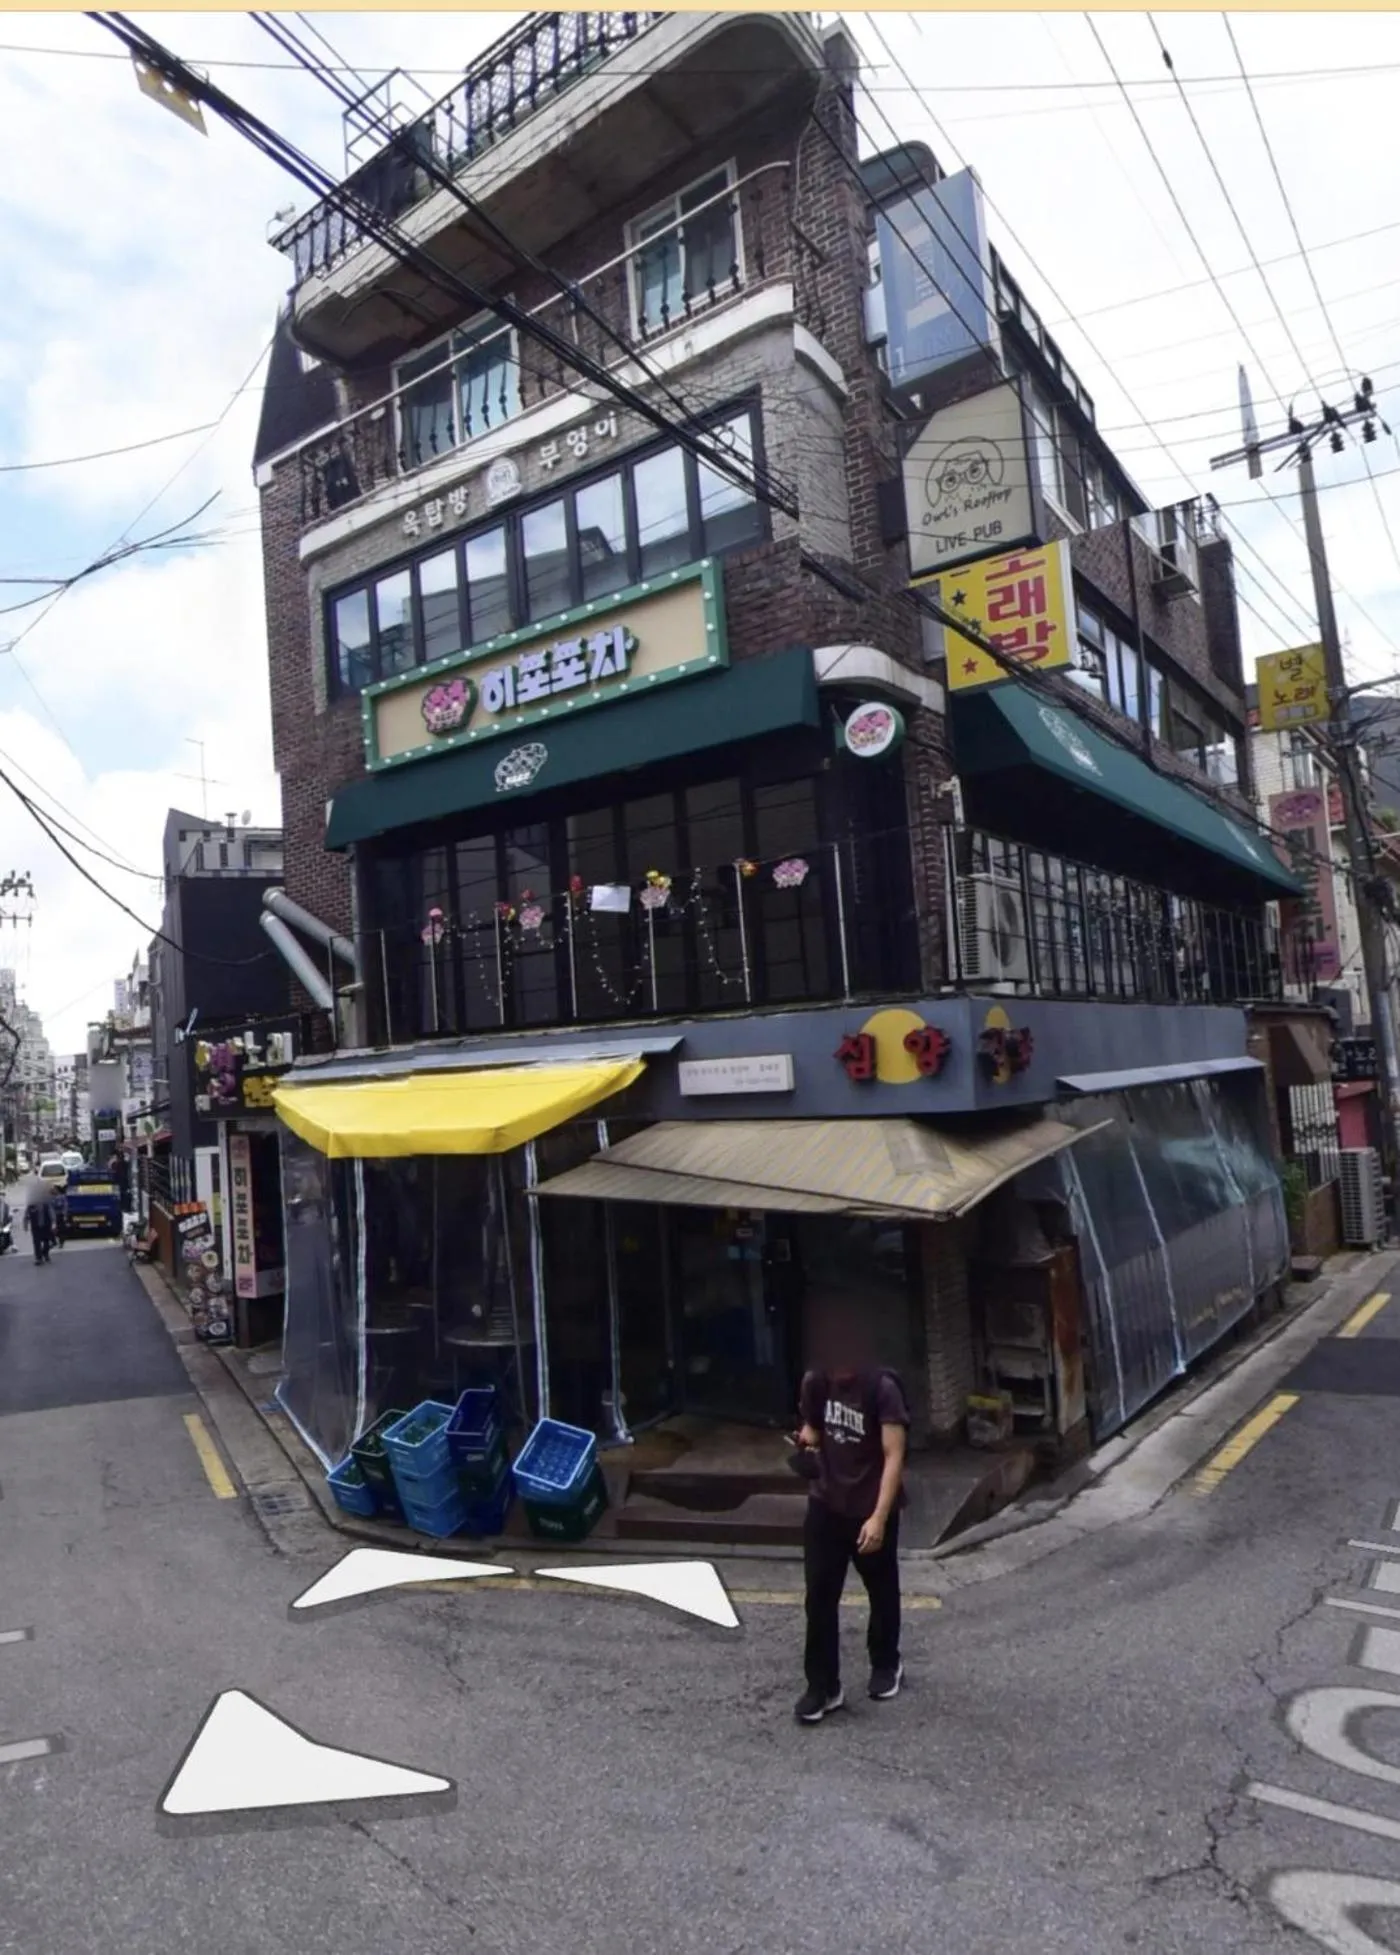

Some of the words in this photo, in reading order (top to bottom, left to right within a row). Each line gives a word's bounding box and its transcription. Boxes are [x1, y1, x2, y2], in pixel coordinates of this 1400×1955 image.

[403, 485, 469, 536] 옥탑방
[935, 531, 967, 554] LIVE
[973, 518, 1003, 541] PUB
[480, 626, 636, 713] 히포포차
